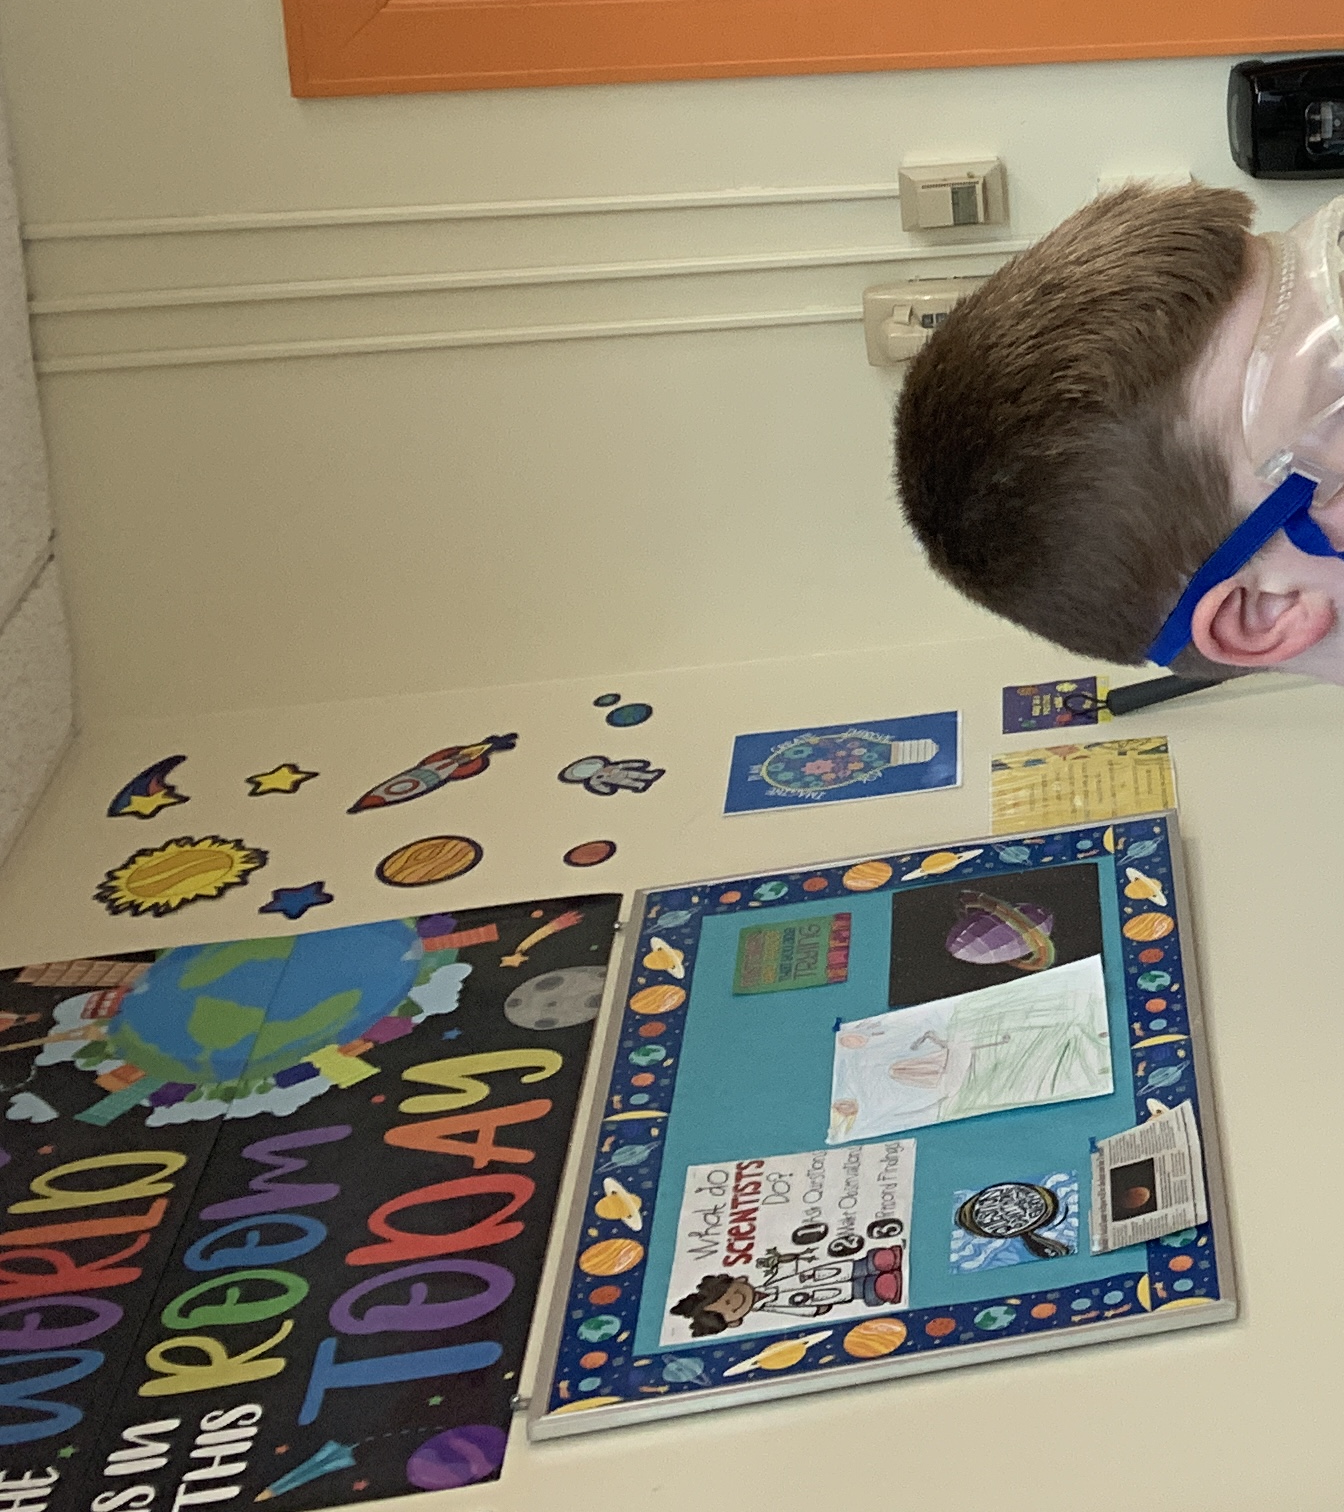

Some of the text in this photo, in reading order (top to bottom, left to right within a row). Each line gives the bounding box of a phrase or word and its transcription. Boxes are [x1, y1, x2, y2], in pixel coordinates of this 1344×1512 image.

[298, 1047, 562, 1425] TODAY
[686, 1168, 729, 1261] What do
[761, 1170, 793, 1205] Do?
[138, 1123, 353, 1512] THIS ROOM
